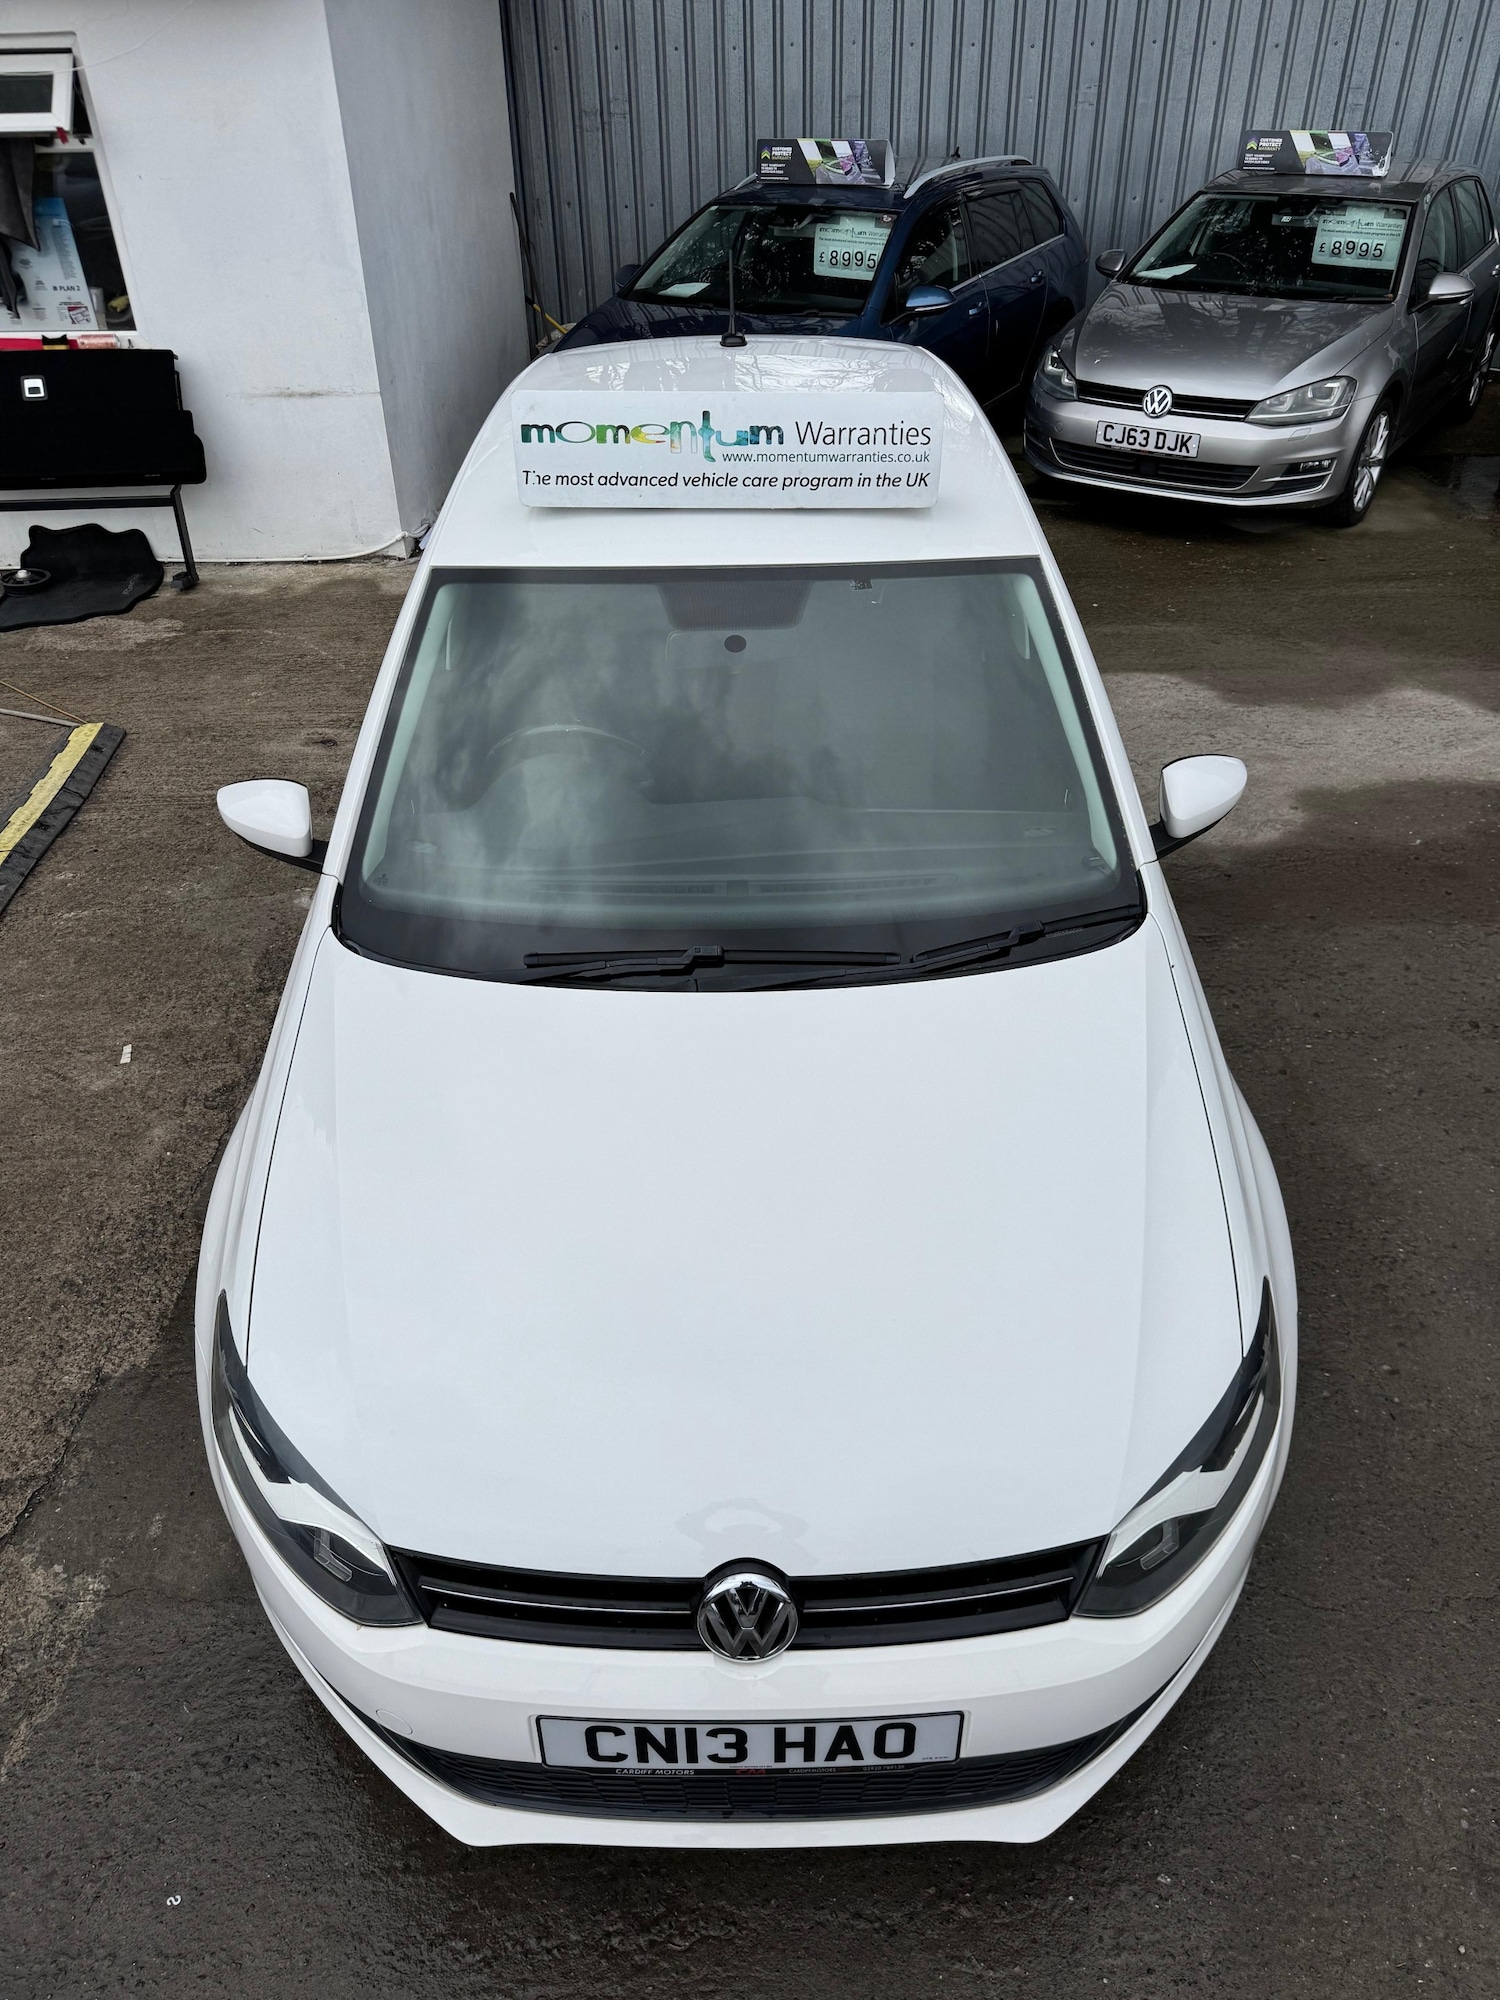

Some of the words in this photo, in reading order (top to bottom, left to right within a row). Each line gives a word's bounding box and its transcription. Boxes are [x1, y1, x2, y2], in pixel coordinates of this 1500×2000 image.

[520, 410, 785, 463] momentum
[795, 421, 931, 446] Warranties
[1103, 424, 1150, 448] CJ63
[1154, 431, 1193, 454] DJK
[721, 451, 930, 464] www.momentumwarranties.co.uk
[522, 470, 552, 486] The
[555, 472, 595, 486] most
[598, 472, 679, 487] advanced
[683, 473, 739, 488] vehicle
[743, 476, 779, 488] care
[782, 476, 854, 491] program
[858, 473, 872, 488] in
[875, 473, 902, 488] the
[906, 473, 931, 488] UK
[584, 1724, 749, 1764] CN13
[773, 1721, 917, 1764] HAO
